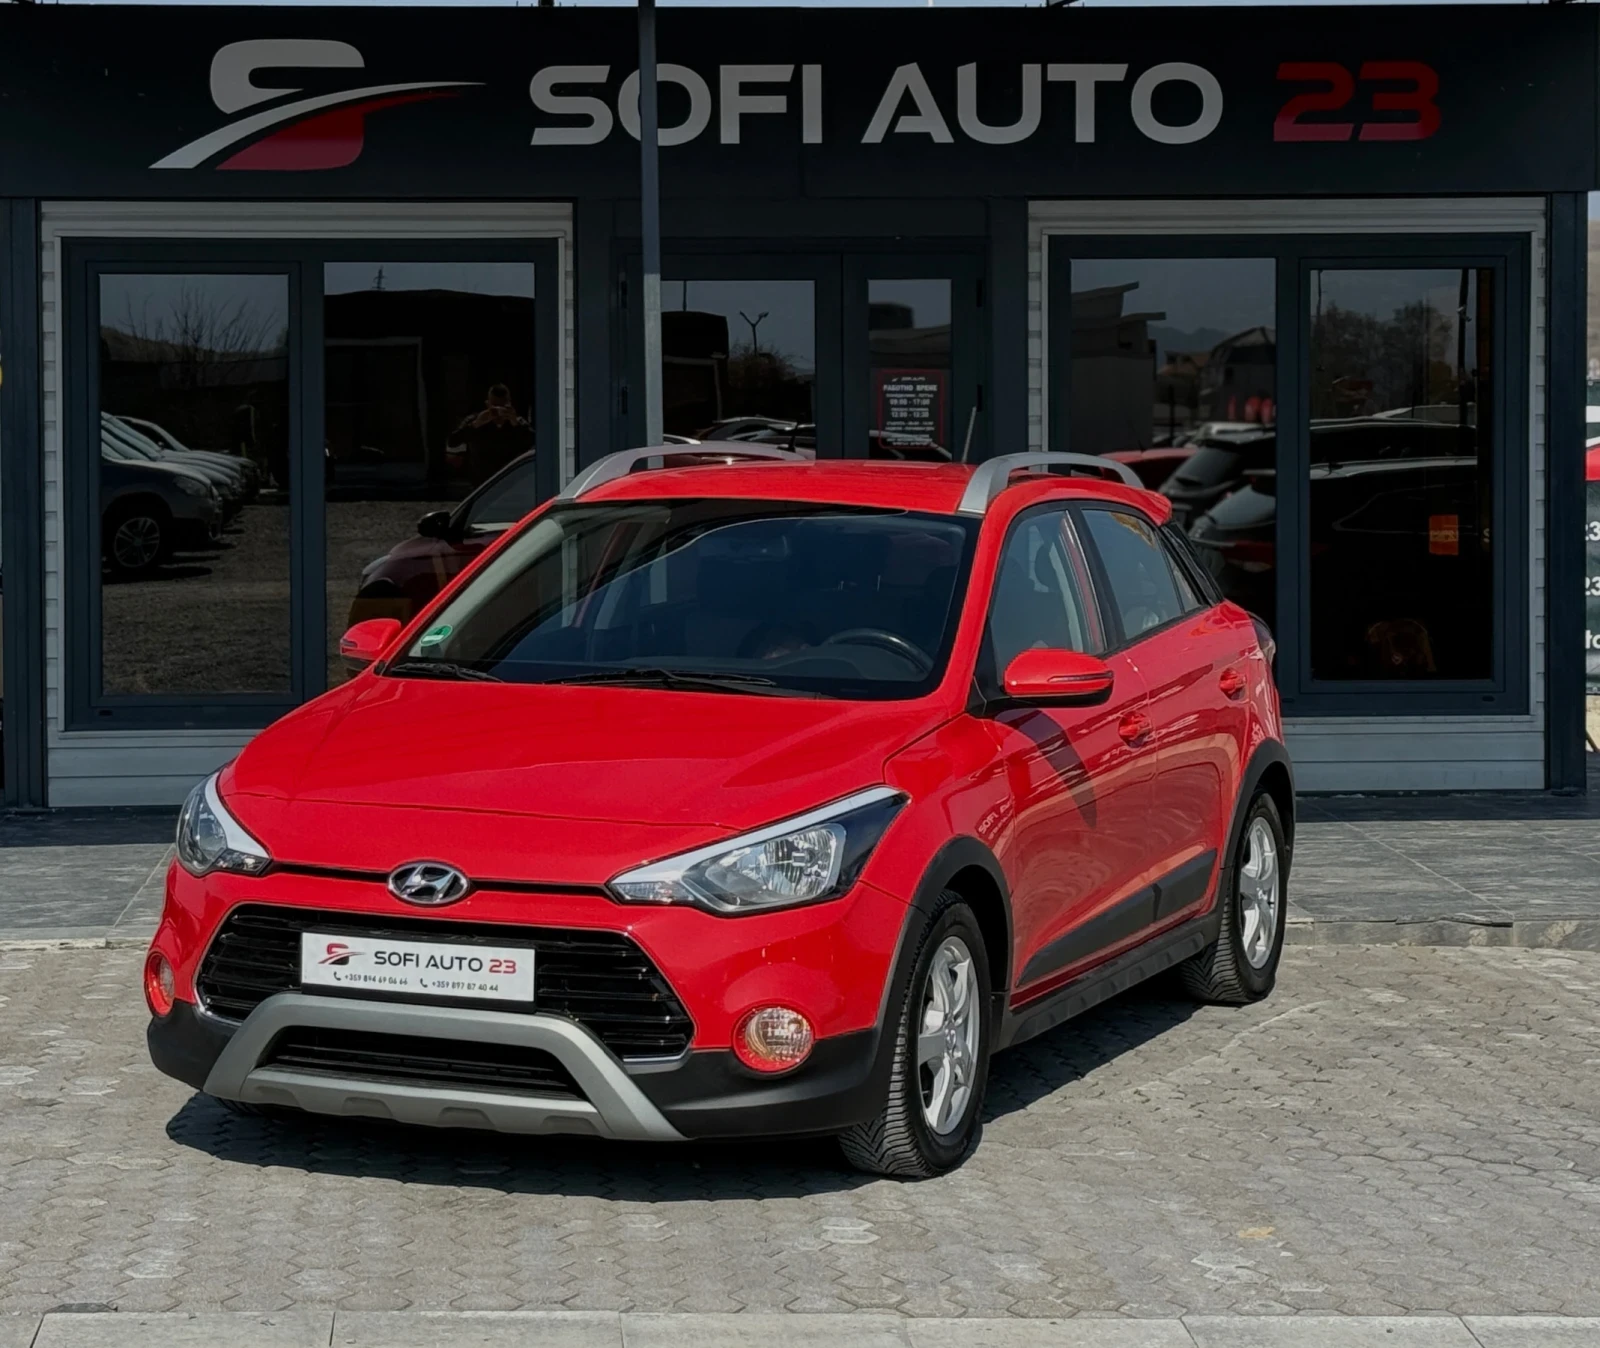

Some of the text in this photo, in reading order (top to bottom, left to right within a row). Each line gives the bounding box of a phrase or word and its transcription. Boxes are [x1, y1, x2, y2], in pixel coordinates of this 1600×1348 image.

[530, 61, 1442, 147] SOFI AUTO 23
[374, 950, 517, 974] SOFI AUTO 23
[344, 973, 362, 982] +359
[432, 980, 450, 989] +359
